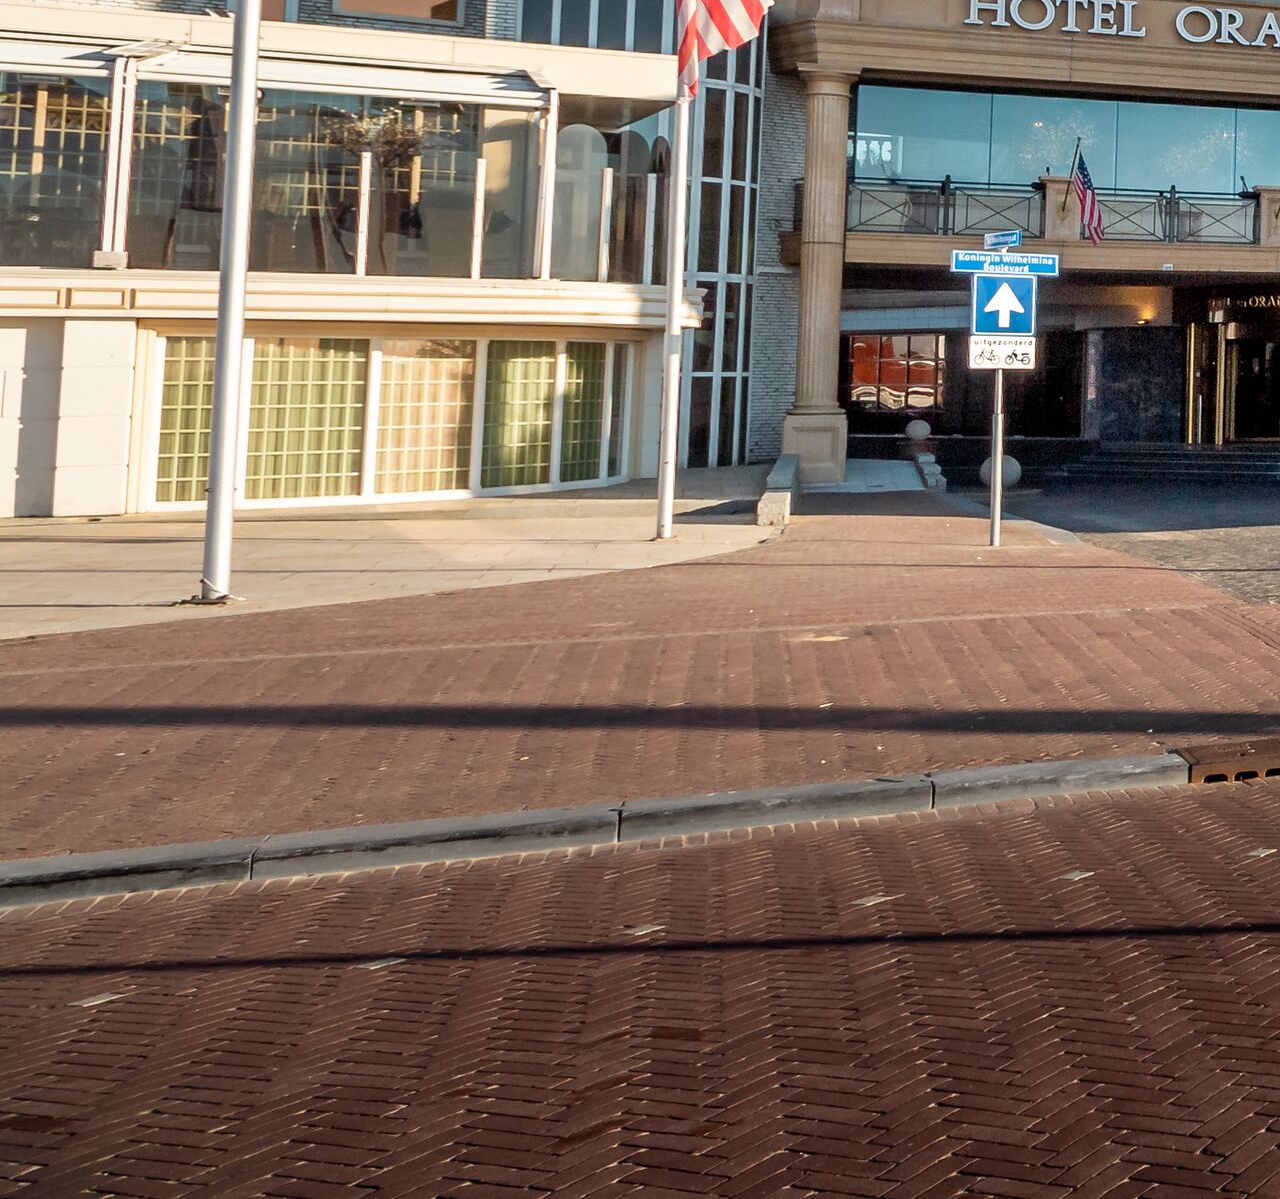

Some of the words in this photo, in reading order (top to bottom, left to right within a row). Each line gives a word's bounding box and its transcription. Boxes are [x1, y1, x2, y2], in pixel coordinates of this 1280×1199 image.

[958, 252, 1000, 264] Koningin
[1002, 254, 1053, 266] Wilhelmina
[983, 263, 1029, 273] Boulevard
[974, 339, 1033, 347] uitgezonderd
